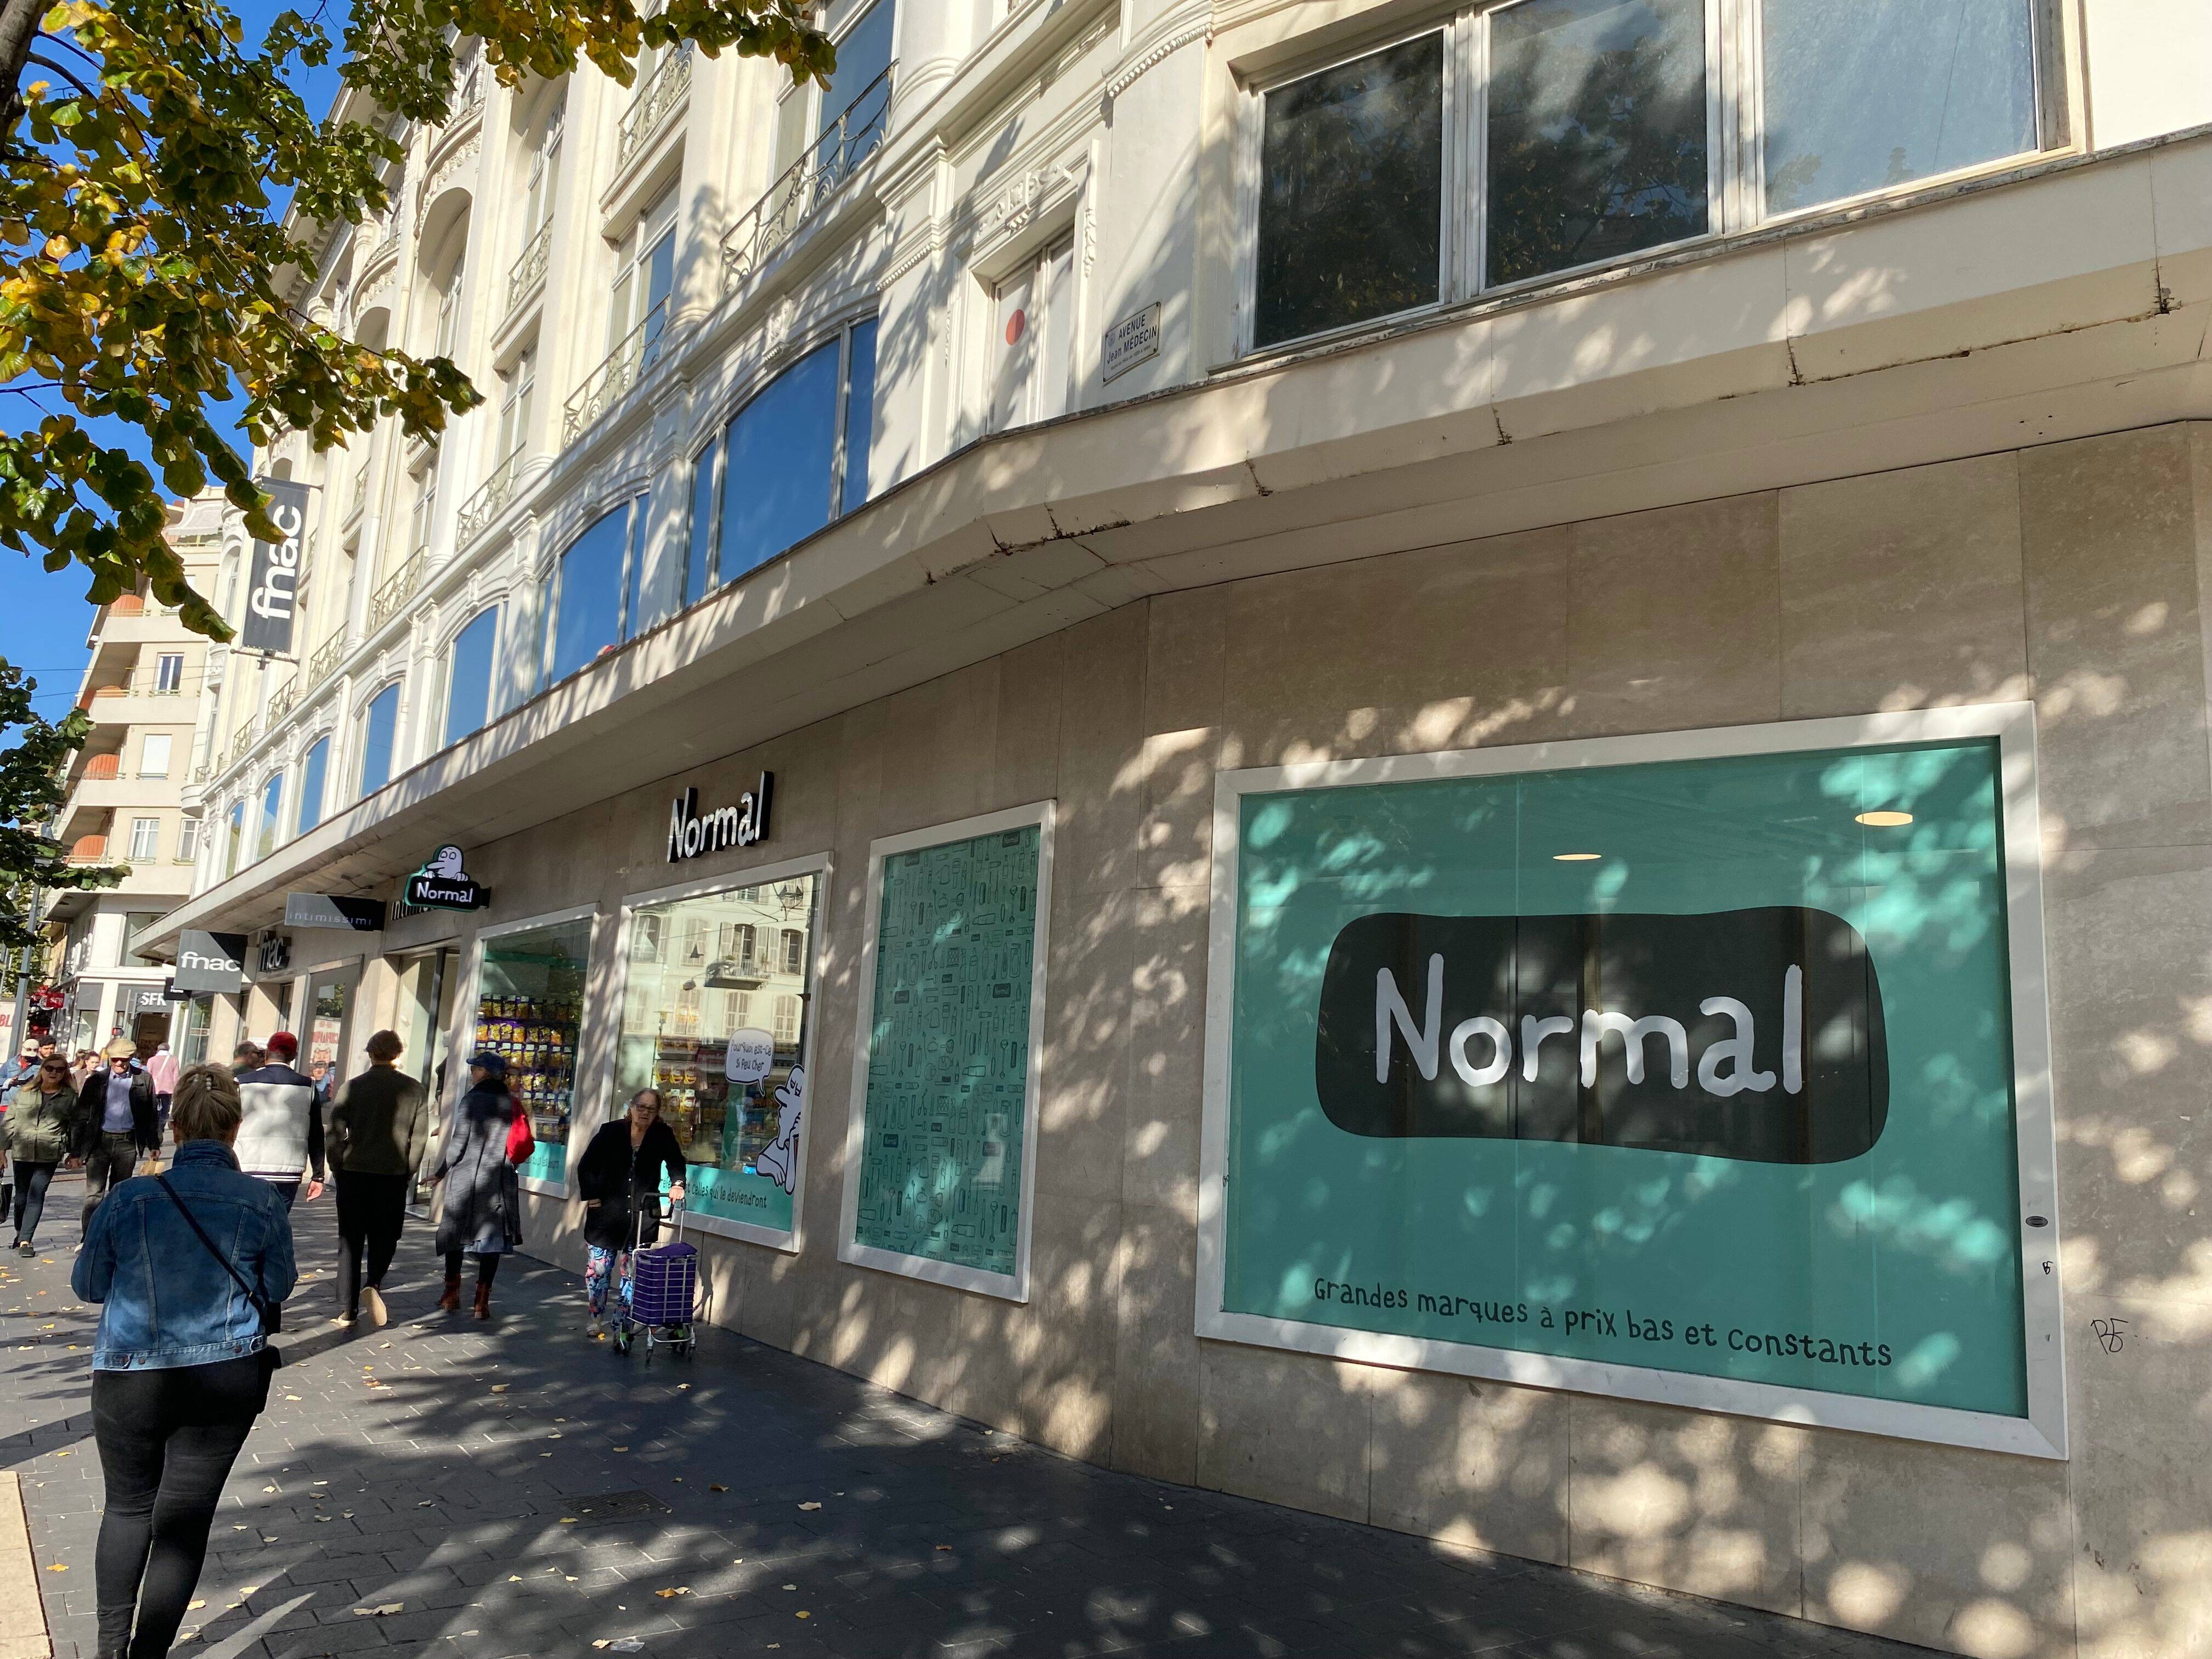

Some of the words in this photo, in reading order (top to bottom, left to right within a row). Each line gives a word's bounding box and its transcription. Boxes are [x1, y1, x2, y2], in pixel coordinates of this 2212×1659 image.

[1119, 314, 1146, 341] AVENUE
[1107, 347, 1121, 364] Jean
[1124, 325, 1157, 353] MÉDECIN
[252, 505, 301, 619] fnac
[667, 770, 772, 863] Normal
[417, 881, 473, 902] Normal
[290, 912, 371, 926] intimissimi
[181, 951, 241, 972] fnac
[260, 931, 287, 971] fnac
[140, 992, 167, 1006] SFR
[1376, 953, 1803, 1097] Normal
[710, 1185, 719, 1200] qui
[720, 1186, 726, 1200] le
[727, 1187, 768, 1208] deviendront
[1314, 1277, 1408, 1308] Grandes
[1418, 1293, 1528, 1323] marques
[1540, 1306, 1554, 1328] à
[1565, 1308, 1617, 1337] prix
[1627, 1310, 1674, 1341] bas
[1685, 1324, 1718, 1347] et
